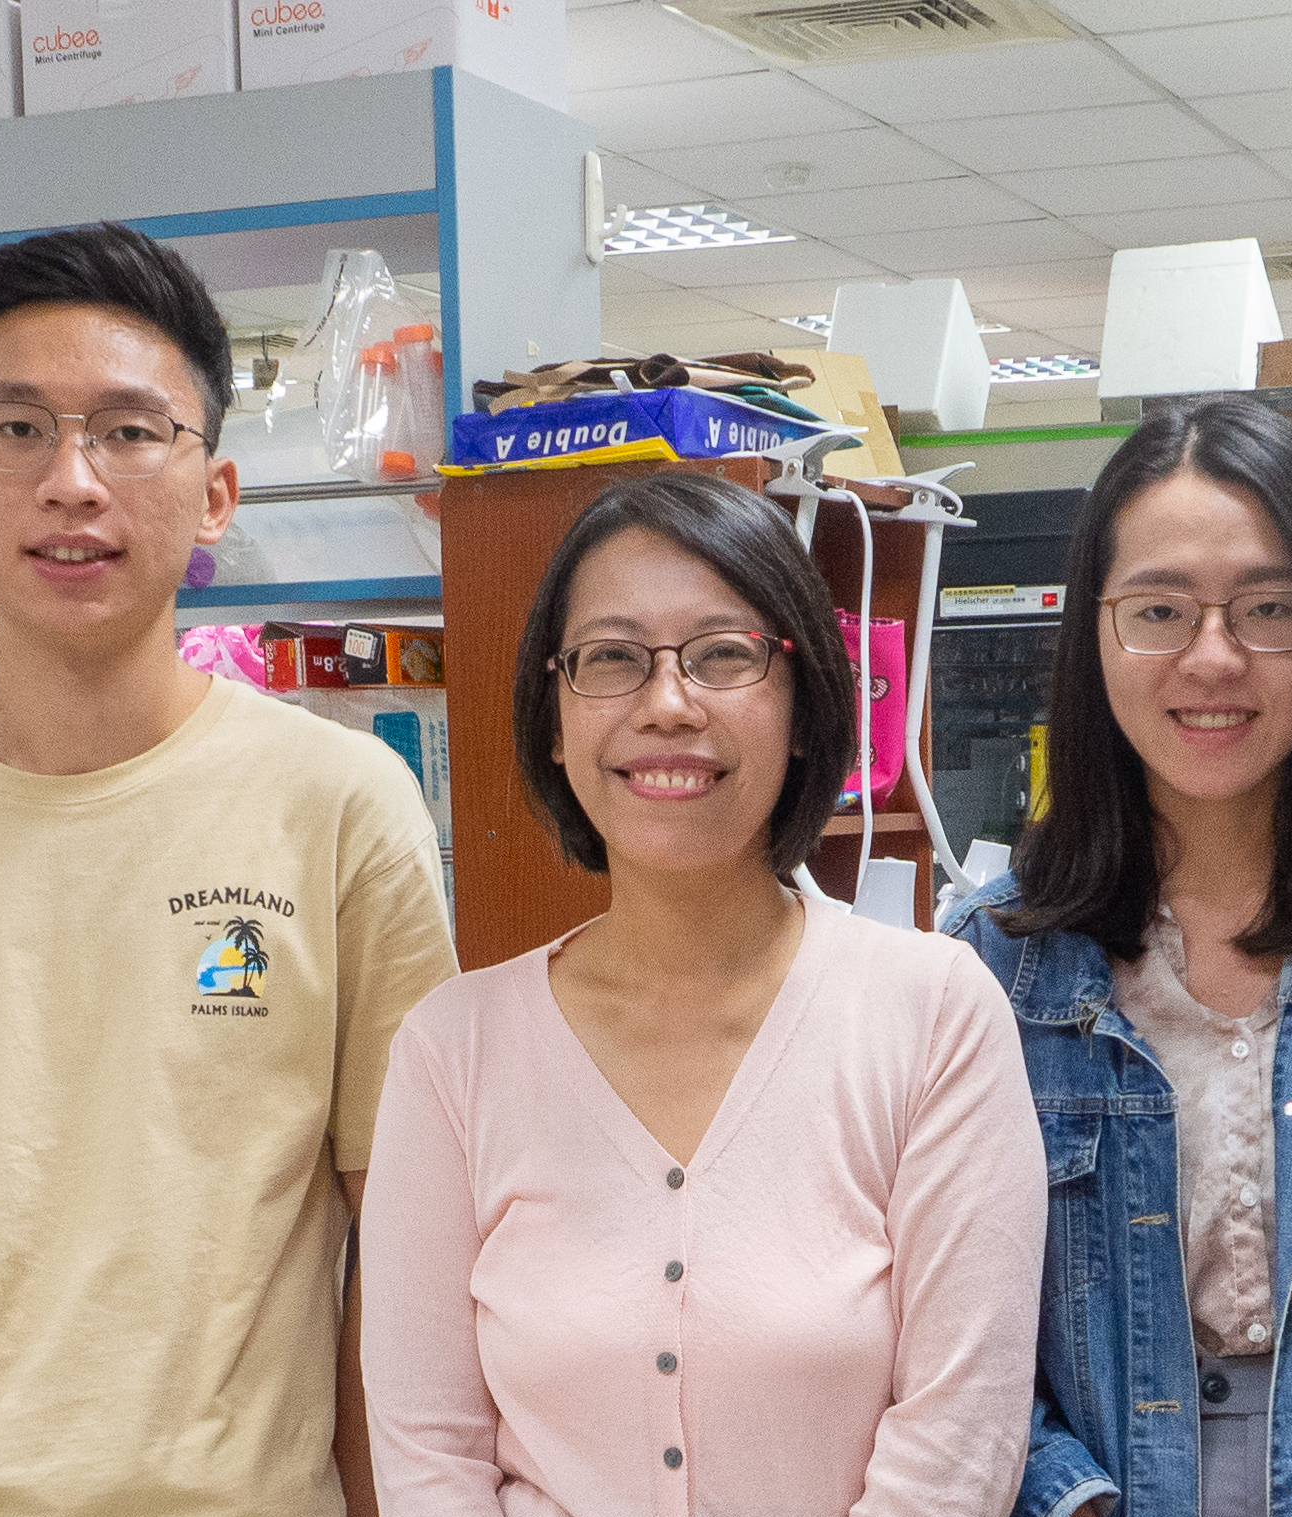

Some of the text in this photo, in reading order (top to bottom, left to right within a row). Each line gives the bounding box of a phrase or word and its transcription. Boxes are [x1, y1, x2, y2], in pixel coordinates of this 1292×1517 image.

[253, 22, 326, 38] Mini Centrifuge
[35, 49, 102, 65] Mini Centrifuge
[495, 421, 629, 460] Double A
[708, 416, 794, 452] ouble A
[168, 886, 296, 918] DREAMLAND
[191, 1004, 269, 1018] PALMS ISLAND
